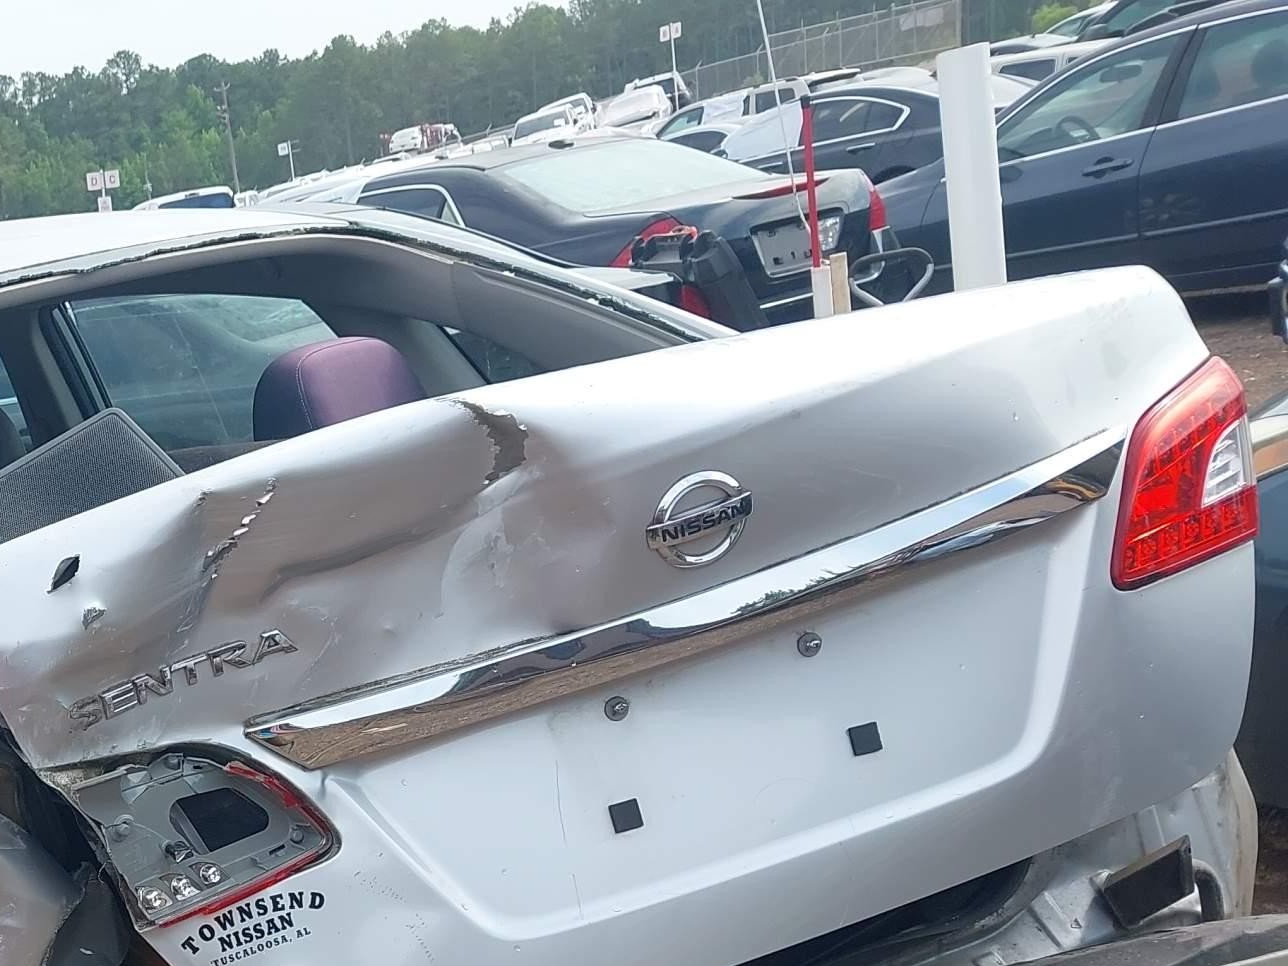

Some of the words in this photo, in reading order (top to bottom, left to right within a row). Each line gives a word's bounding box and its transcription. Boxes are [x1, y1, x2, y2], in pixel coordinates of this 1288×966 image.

[660, 500, 745, 542] NISSAN
[68, 628, 299, 731] SENTRA
[180, 891, 326, 955] TOWNSEND
[217, 912, 295, 952] NISSAN
[296, 926, 312, 939] AL
